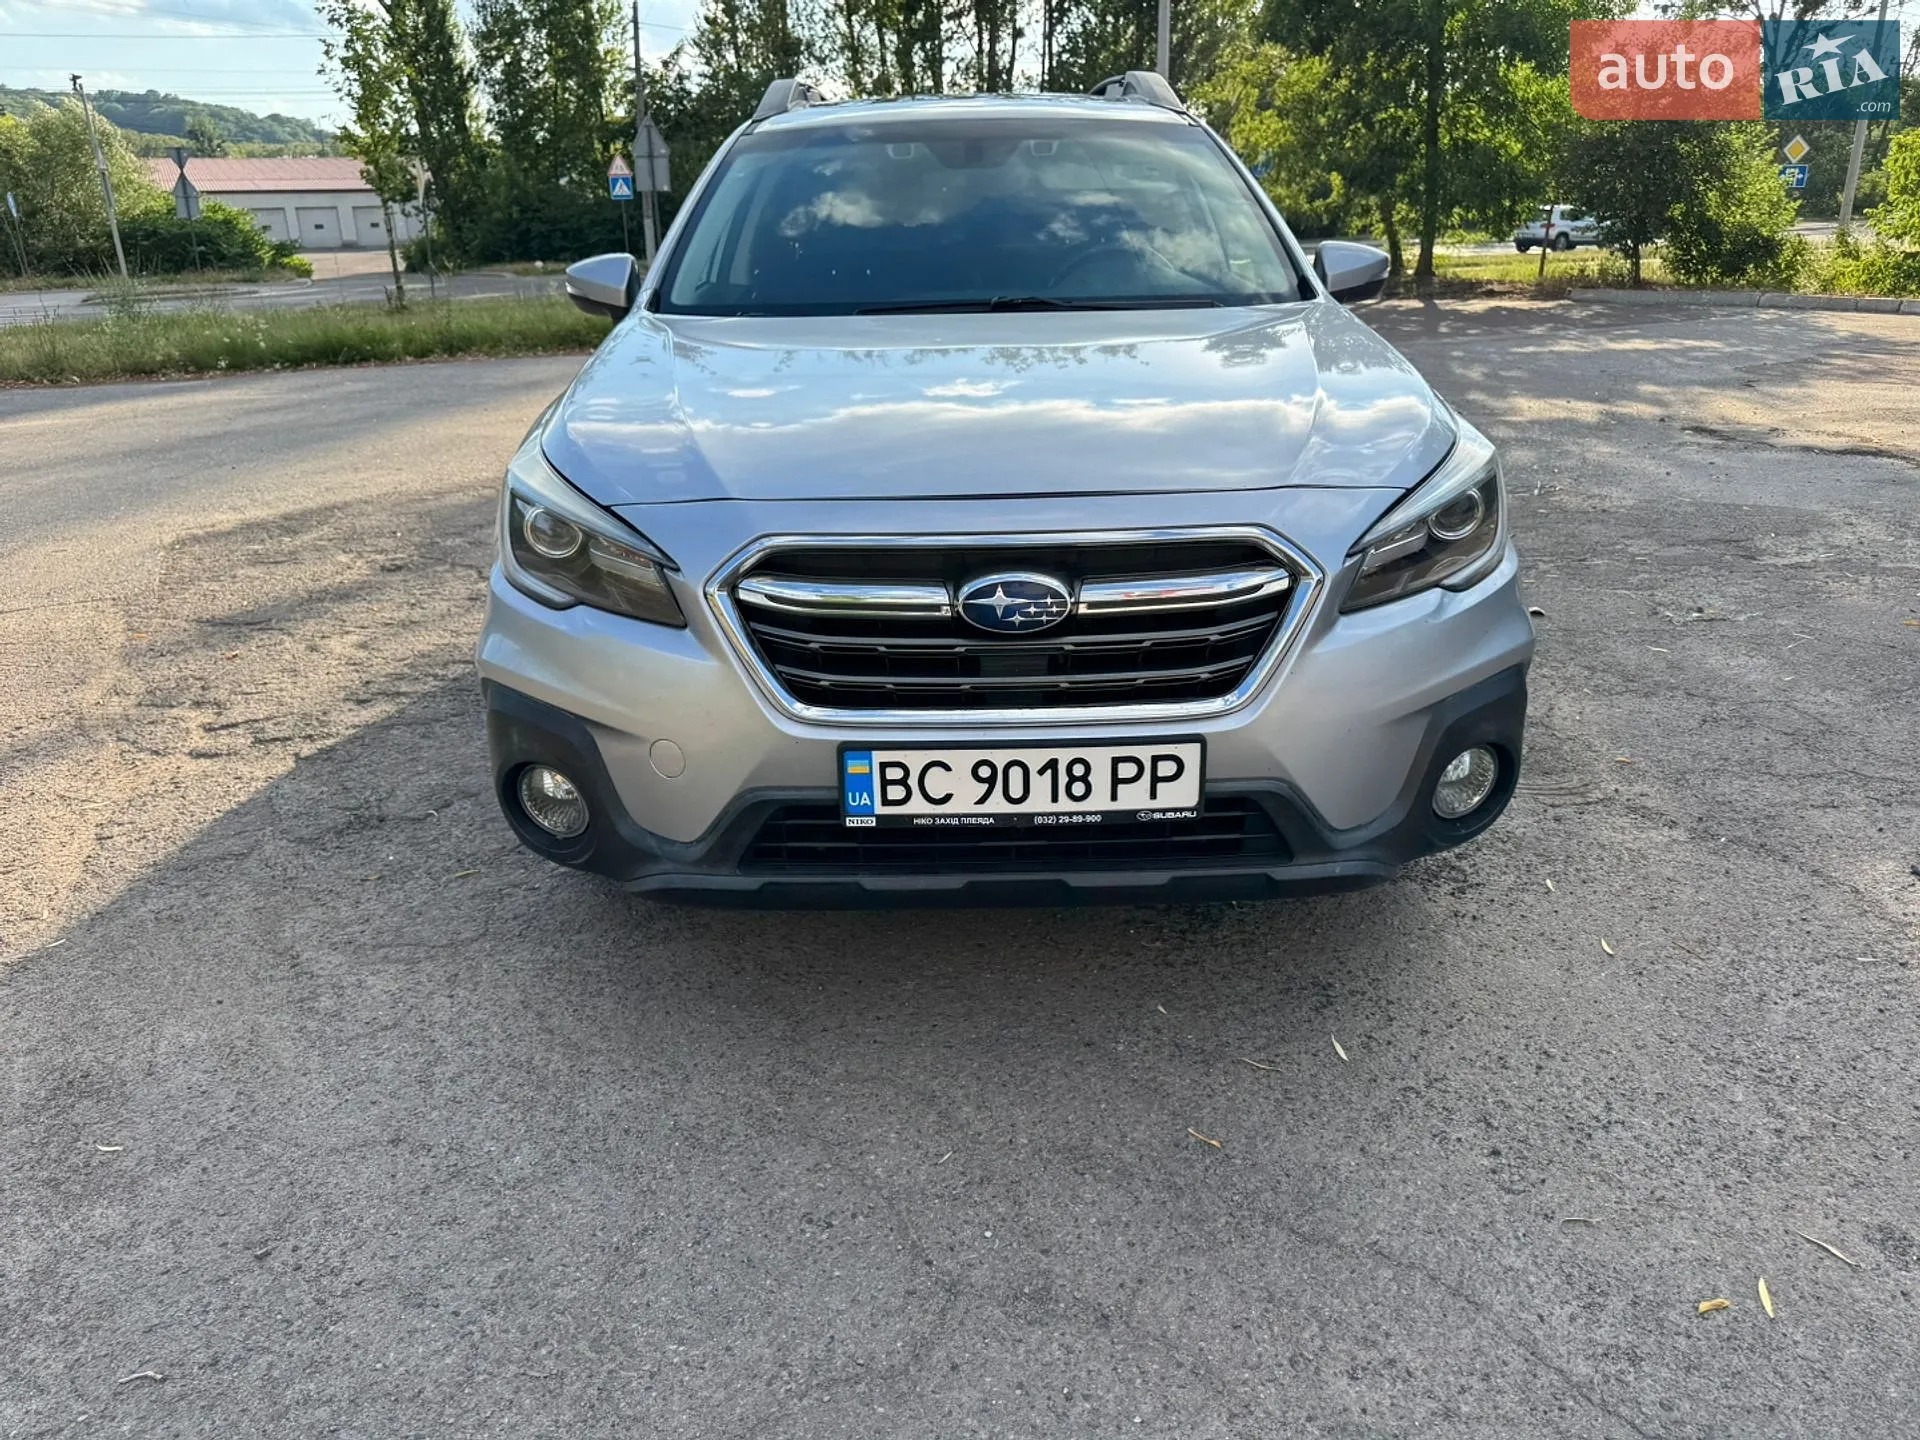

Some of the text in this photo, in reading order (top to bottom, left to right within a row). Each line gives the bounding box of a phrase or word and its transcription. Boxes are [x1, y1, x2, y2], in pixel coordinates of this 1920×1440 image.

[880, 753, 1185, 807] BC 9018 PP
[848, 792, 871, 807] UA
[1034, 814, 1057, 825] (032)
[1151, 810, 1197, 820] SUBARU
[847, 818, 874, 826] NIKO
